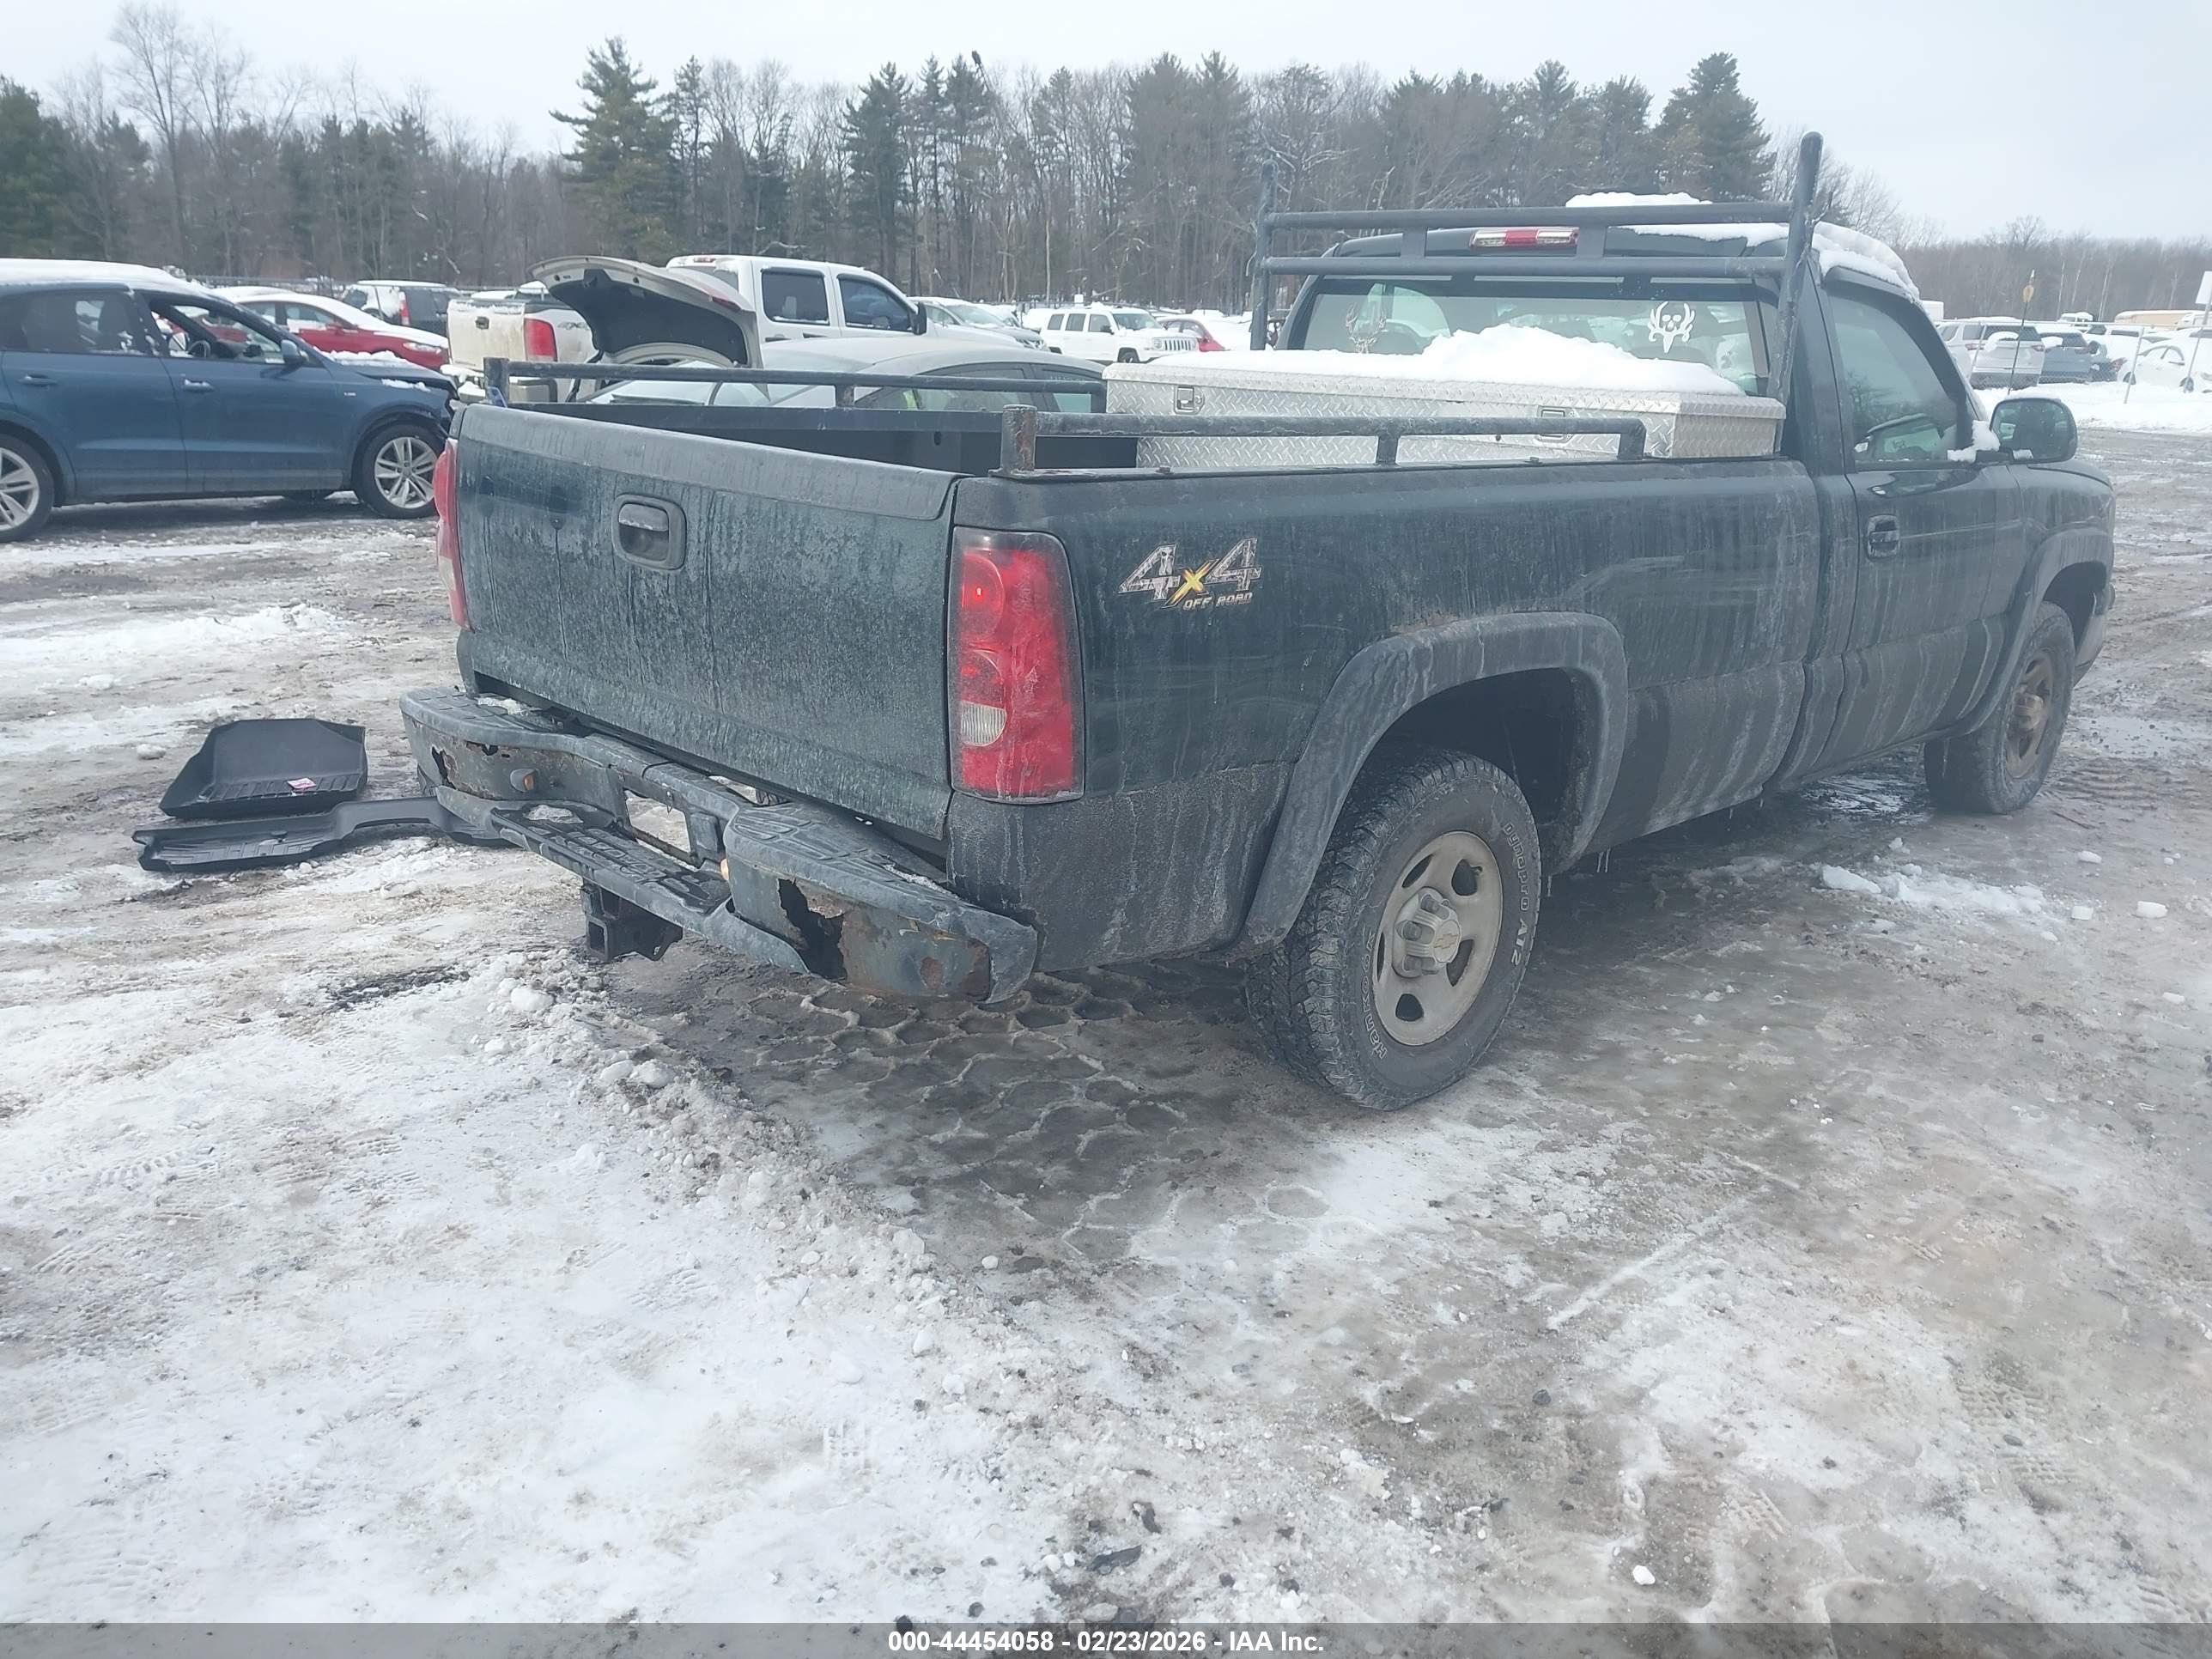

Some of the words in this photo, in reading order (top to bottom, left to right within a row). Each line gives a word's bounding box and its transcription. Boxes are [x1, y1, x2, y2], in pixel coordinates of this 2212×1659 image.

[1183, 596, 1212, 611] OFF
[1216, 592, 1253, 607] ROAD
[1504, 823, 1529, 911] Dynapro
[1511, 917, 1528, 966] AT2
